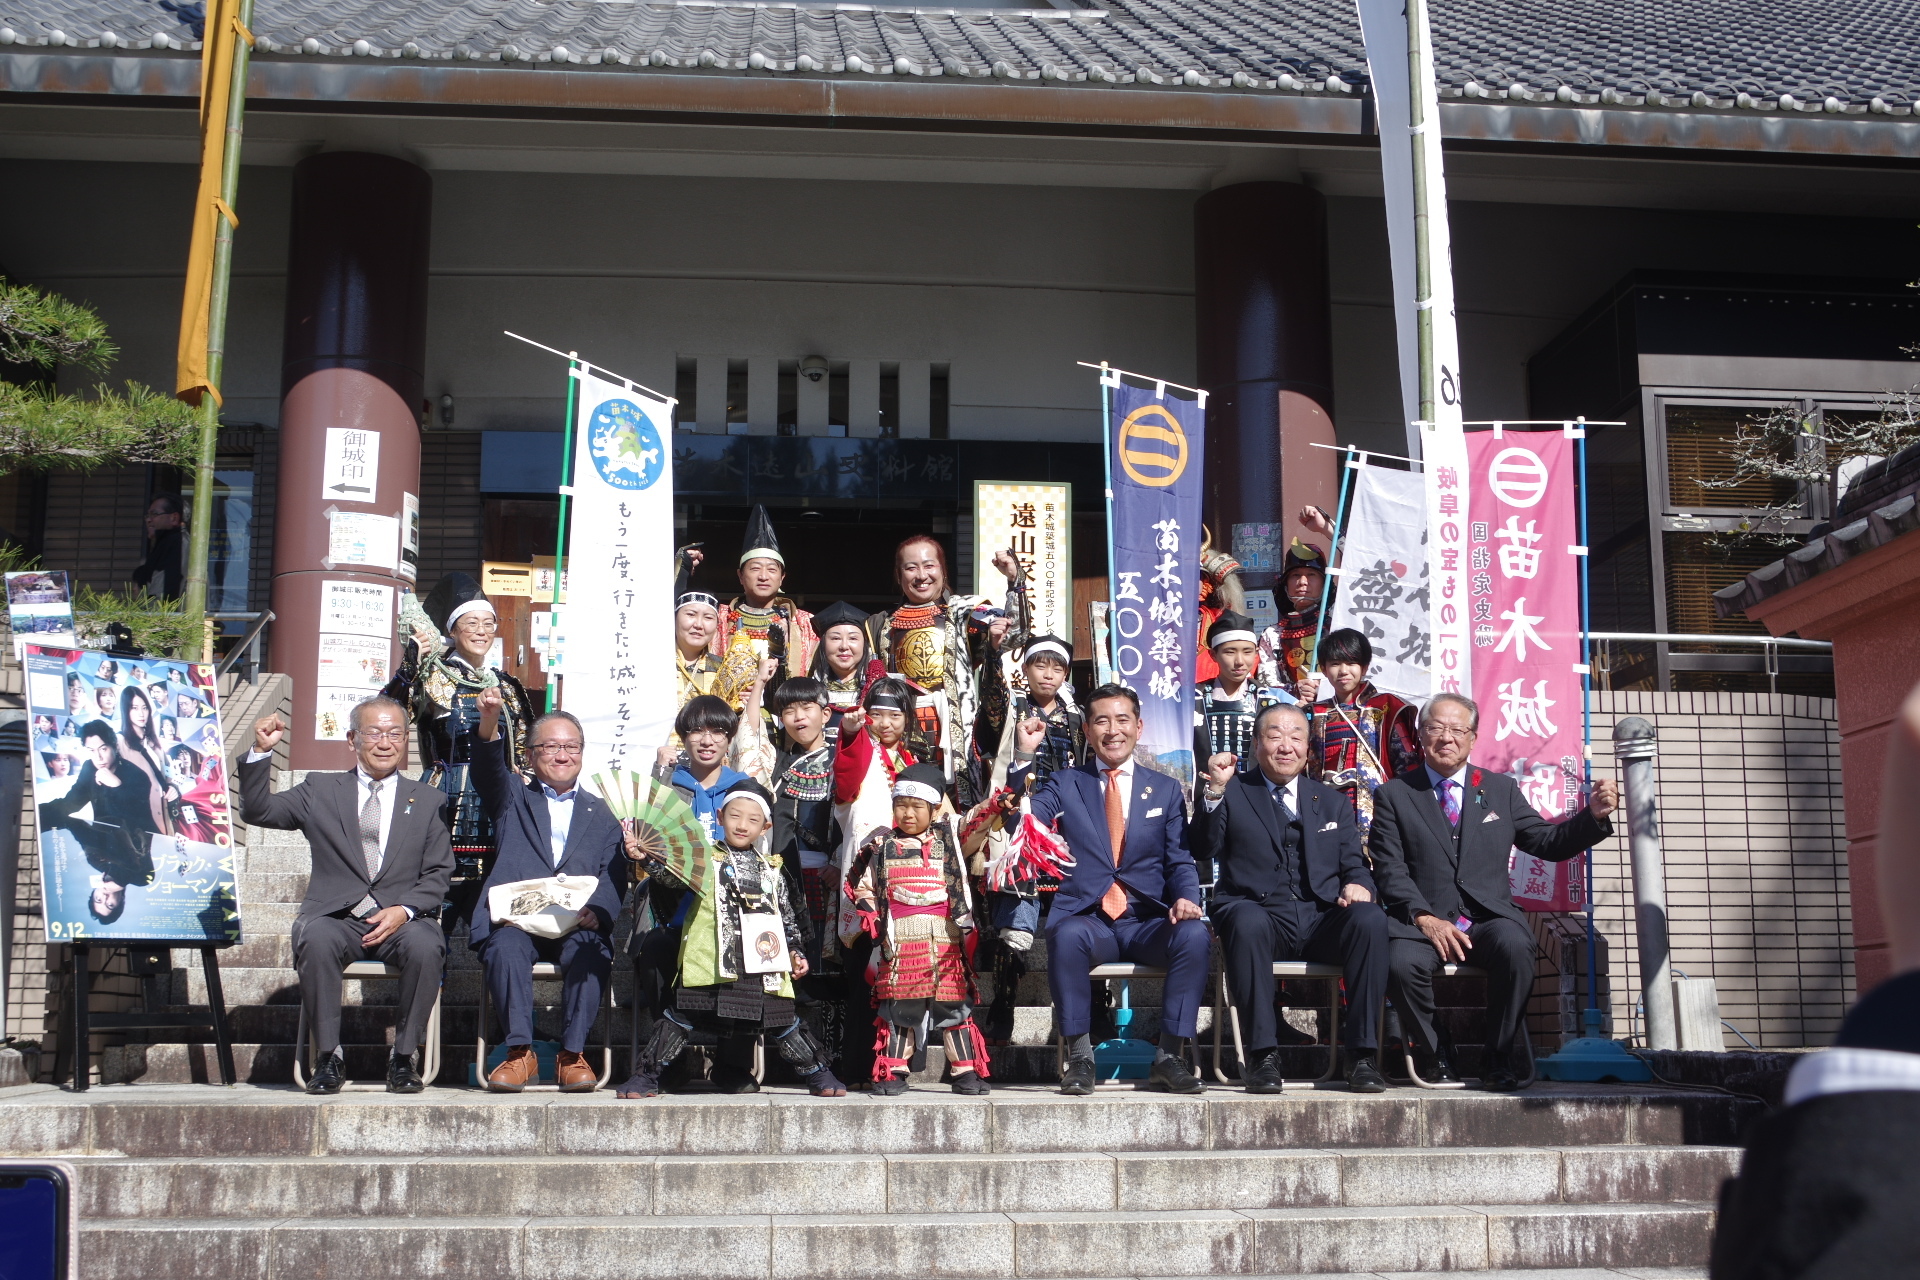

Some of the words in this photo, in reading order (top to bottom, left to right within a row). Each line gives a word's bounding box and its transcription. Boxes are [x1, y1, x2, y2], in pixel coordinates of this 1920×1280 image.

[610, 402, 642, 421] 苗木城
[341, 430, 367, 480] 御城印
[1147, 518, 1183, 704] 苗木城築城
[1116, 571, 1144, 705] 五〇〇
[146, 871, 219, 894] ショーマン
[51, 921, 84, 938] 9.12
